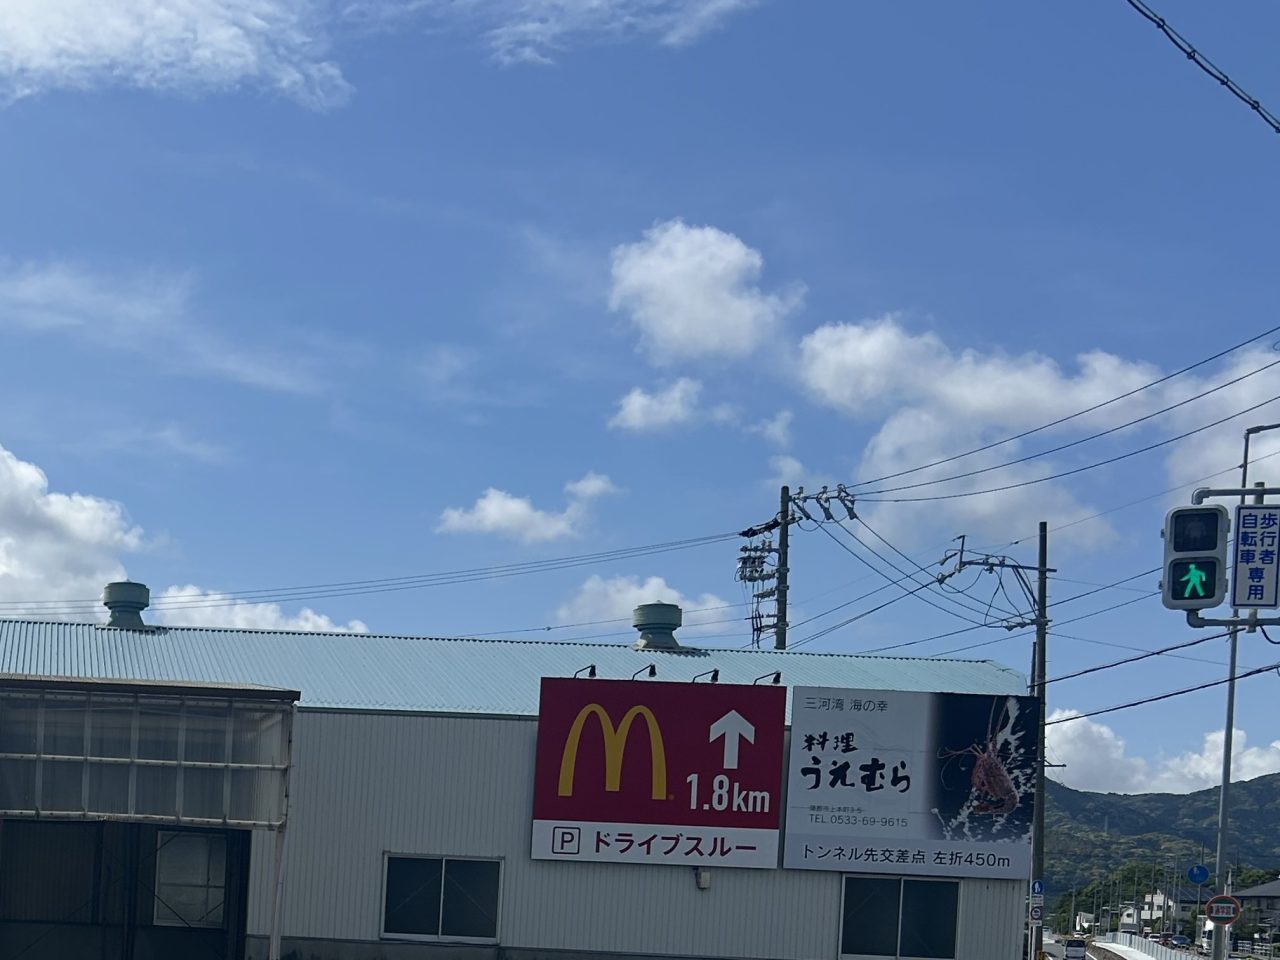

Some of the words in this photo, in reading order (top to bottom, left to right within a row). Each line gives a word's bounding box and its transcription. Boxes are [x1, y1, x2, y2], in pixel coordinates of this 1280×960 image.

[1240, 513, 1258, 565] 自転車
[1259, 513, 1278, 565] 歩行者
[1247, 567, 1265, 601] 専用
[803, 697, 844, 711] 三河湾
[849, 699, 888, 712] 海の幸
[802, 731, 858, 753] 料理
[801, 756, 910, 794] うえむら
[595, 830, 757, 857] ドライブスルー
[803, 844, 926, 865] トンネル先交差点
[932, 851, 1010, 867] 左折450m
